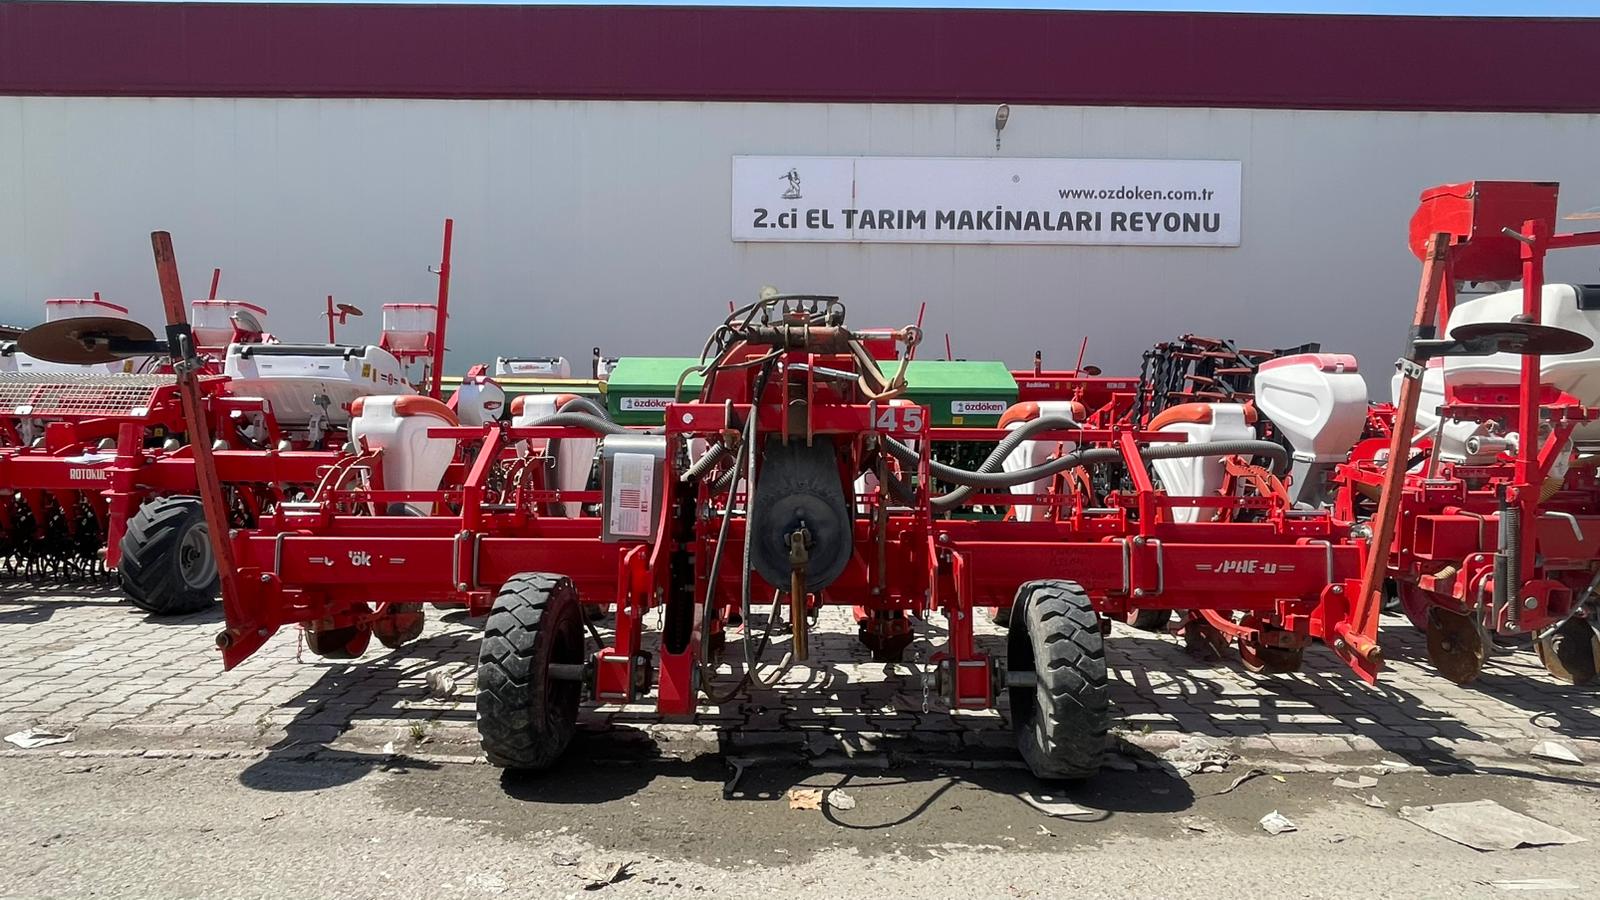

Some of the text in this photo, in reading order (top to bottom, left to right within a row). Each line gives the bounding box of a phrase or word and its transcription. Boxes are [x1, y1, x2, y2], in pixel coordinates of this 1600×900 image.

[1058, 186, 1214, 201] www.ozdoken.com.tr
[753, 205, 1220, 233] 2.ci EL TARIM MAKİNALARI REYONU
